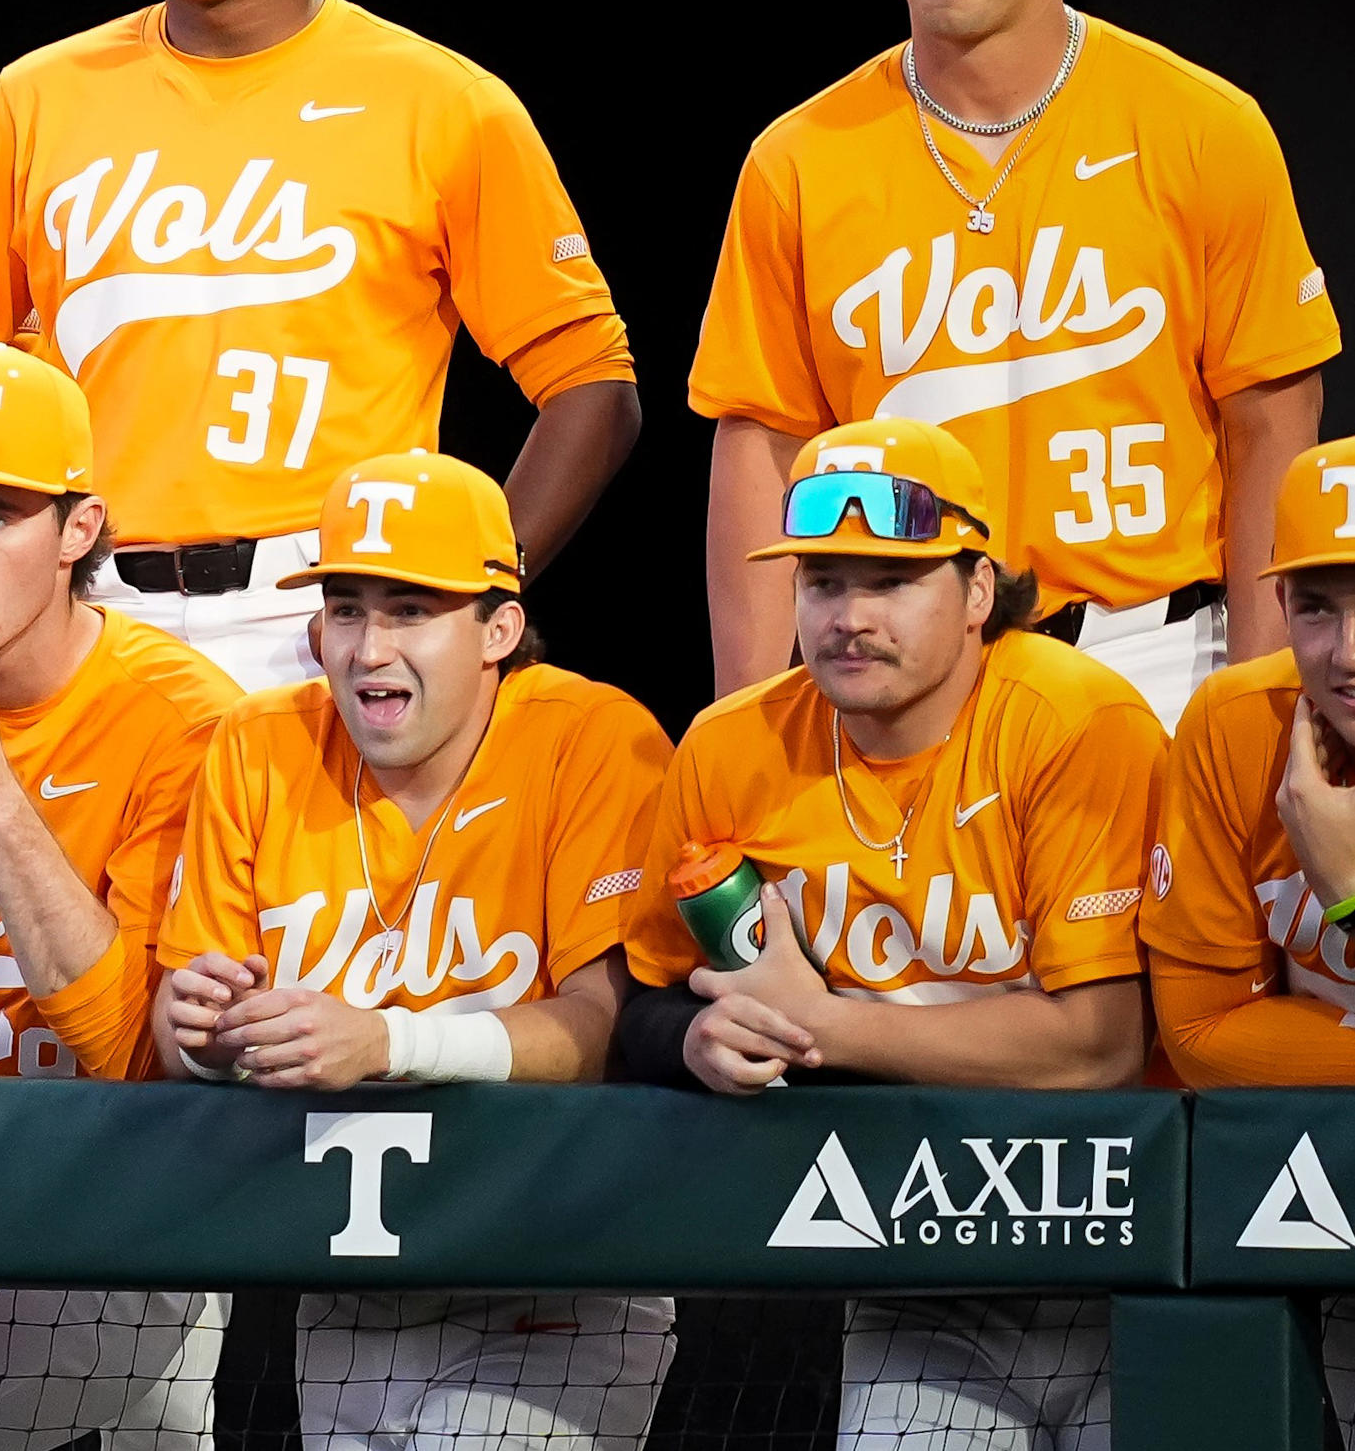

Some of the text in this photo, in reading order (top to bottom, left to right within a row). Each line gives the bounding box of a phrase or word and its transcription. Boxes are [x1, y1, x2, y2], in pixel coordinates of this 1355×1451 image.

[44, 149, 340, 283] Vols
[966, 209, 995, 234] 35
[831, 224, 1145, 380] Vols
[205, 348, 330, 470] 37
[346, 479, 416, 554] T
[1047, 421, 1167, 545] 35
[259, 880, 525, 1012] Vols
[776, 861, 1029, 984] Vols
[304, 1112, 433, 1257] T
[890, 1136, 1135, 1218] AXLE
[893, 1220, 1135, 1247] LOGISTICS
